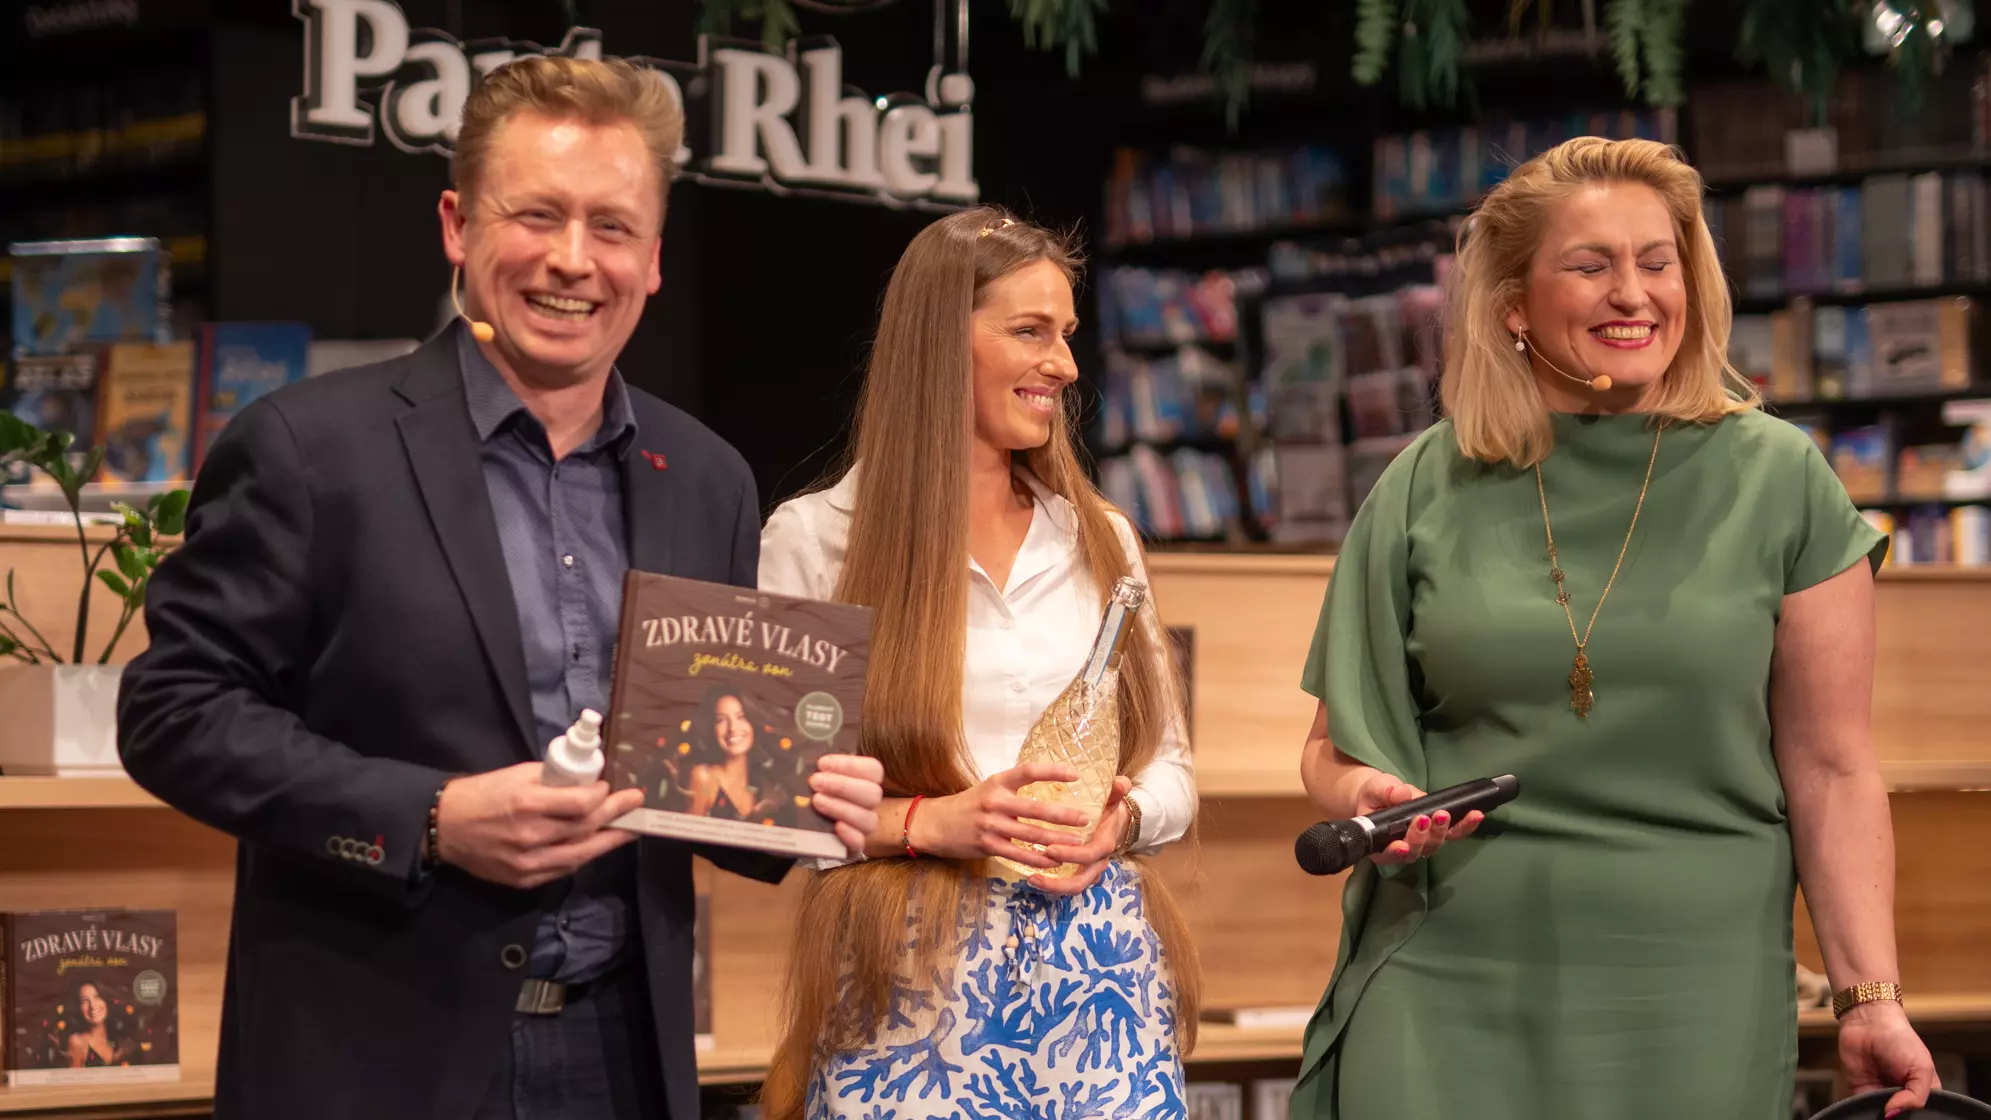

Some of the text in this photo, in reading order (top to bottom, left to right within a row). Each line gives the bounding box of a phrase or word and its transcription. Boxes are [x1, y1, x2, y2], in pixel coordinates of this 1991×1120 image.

[710, 47, 980, 198] Rhei
[641, 610, 848, 675] ZDRAVÉ VLASY
[21, 923, 163, 963] ZDRAVÉ VLASY
